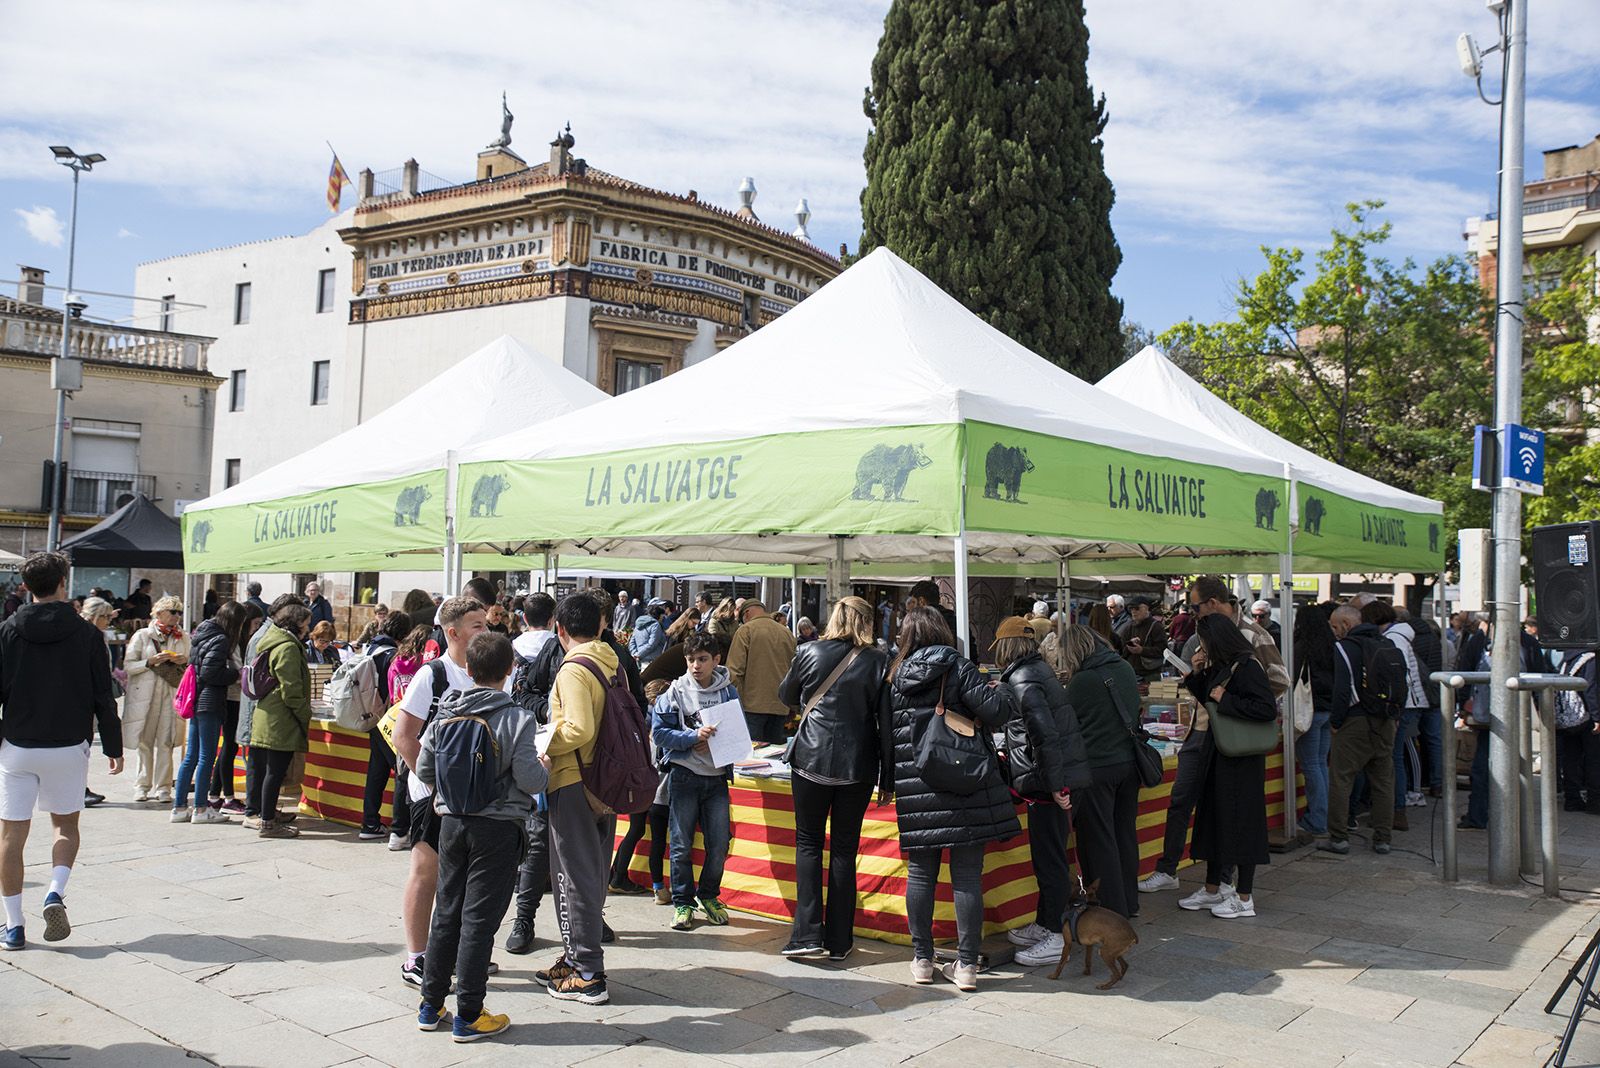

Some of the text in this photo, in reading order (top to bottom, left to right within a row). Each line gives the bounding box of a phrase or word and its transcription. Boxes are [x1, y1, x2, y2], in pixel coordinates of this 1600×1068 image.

[369, 239, 543, 279] GRAN TERRISSERIA DE ARPI
[600, 241, 668, 267] FABRICA
[678, 255, 698, 272] DE
[705, 260, 766, 290] PRODUCTES
[584, 454, 742, 507] LA SALVATGE
[1108, 464, 1206, 518] LA SALVATGE
[254, 500, 338, 543] LA SALVATGE
[1360, 511, 1407, 547] LA SALVATGE
[557, 872, 574, 955] COLLUSION
